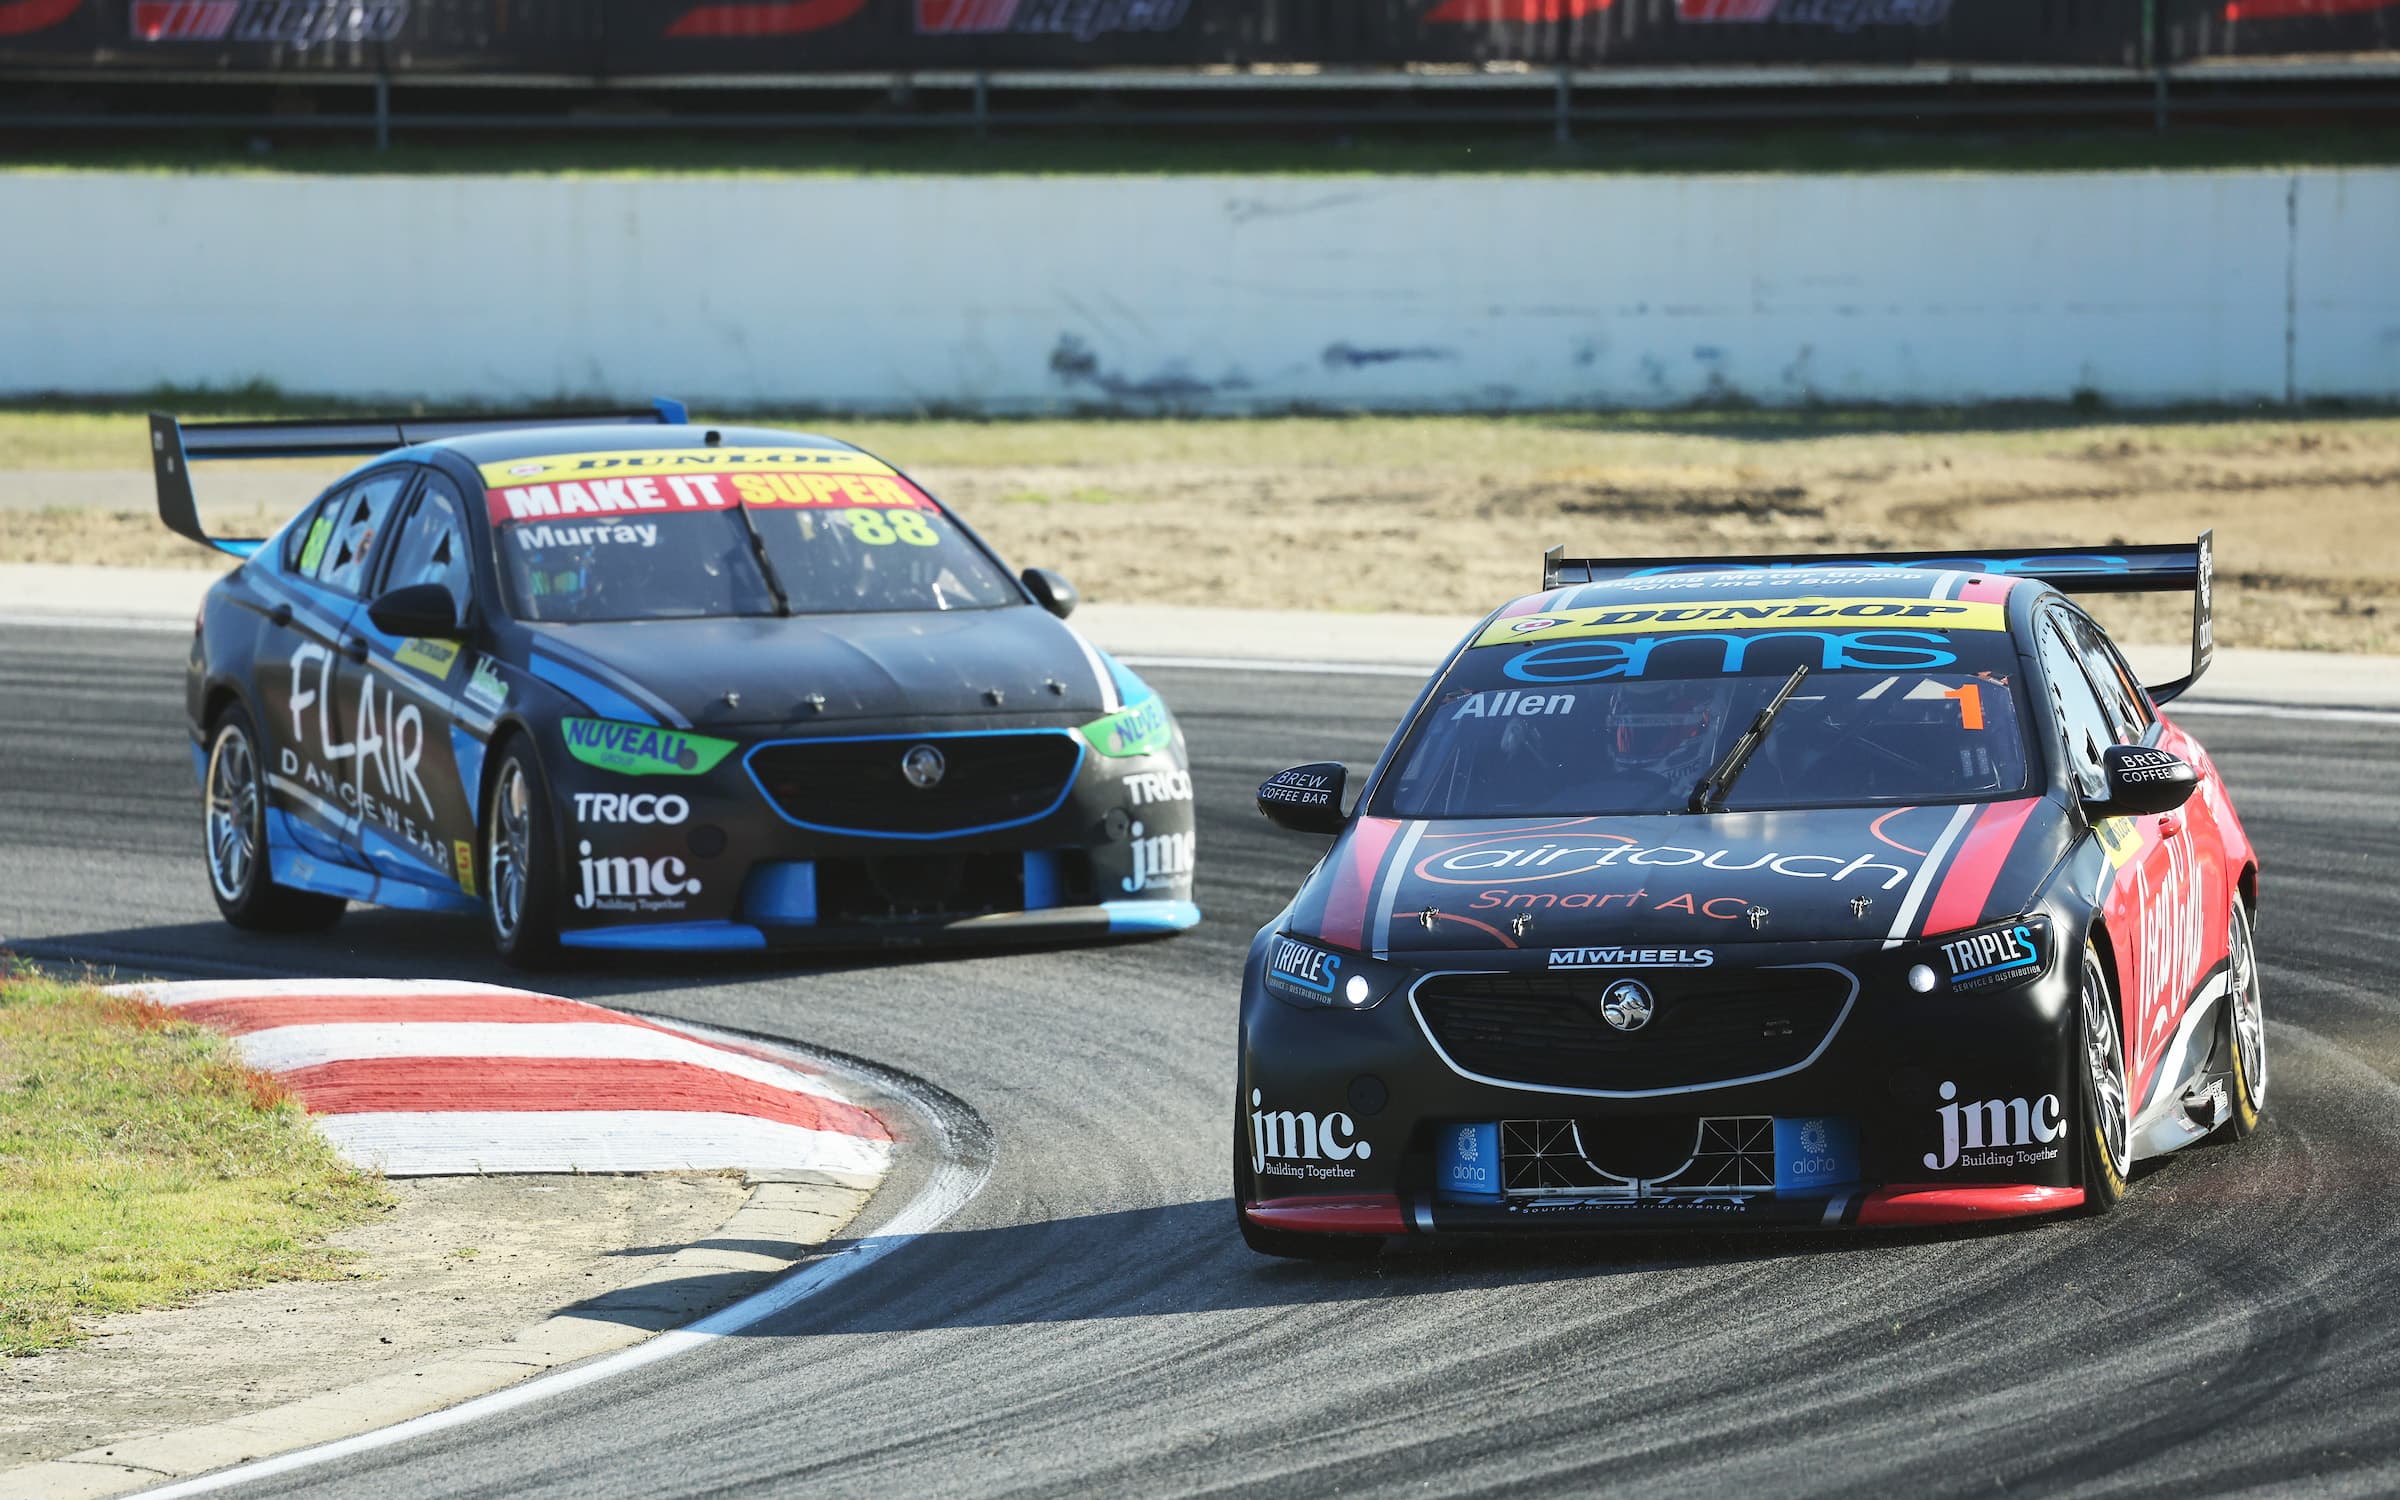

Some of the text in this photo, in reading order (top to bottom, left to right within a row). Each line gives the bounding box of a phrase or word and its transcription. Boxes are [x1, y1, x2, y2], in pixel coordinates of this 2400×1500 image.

[572, 454, 852, 470] DUNLOP
[504, 473, 915, 519] MAKE IT SUPER
[516, 523, 658, 551] Murray
[845, 507, 940, 547] 88
[1581, 604, 1968, 626] DUNLOP
[1503, 631, 1957, 683] ems
[1451, 691, 1575, 720] Allen
[1944, 684, 1984, 730] 1
[290, 641, 434, 823] FLAIR
[568, 720, 687, 764] NUVEAU
[2121, 752, 2172, 768] BREW
[2122, 767, 2172, 783] COFFEE
[1277, 771, 1329, 788] BREW
[281, 748, 450, 869] DANCEWEAR
[574, 793, 690, 824] TRICO
[1262, 787, 1328, 804] COFFEE BAR
[575, 840, 702, 909] jmc.
[1443, 845, 1908, 890] airtouch
[1469, 888, 1748, 919] Smart AC
[1272, 940, 1341, 992] TRIPLES
[1941, 926, 2037, 978] TRIPLES
[1995, 965, 2041, 982] DISTRIBUTION
[1251, 1088, 1371, 1174] jmc.
[1923, 1081, 2067, 1170] jmc.
[1266, 1162, 1356, 1180] Building Together
[1453, 1163, 1485, 1181] aloha
[1793, 1155, 1835, 1174] aloha
[1961, 1147, 2058, 1167] Building Together
